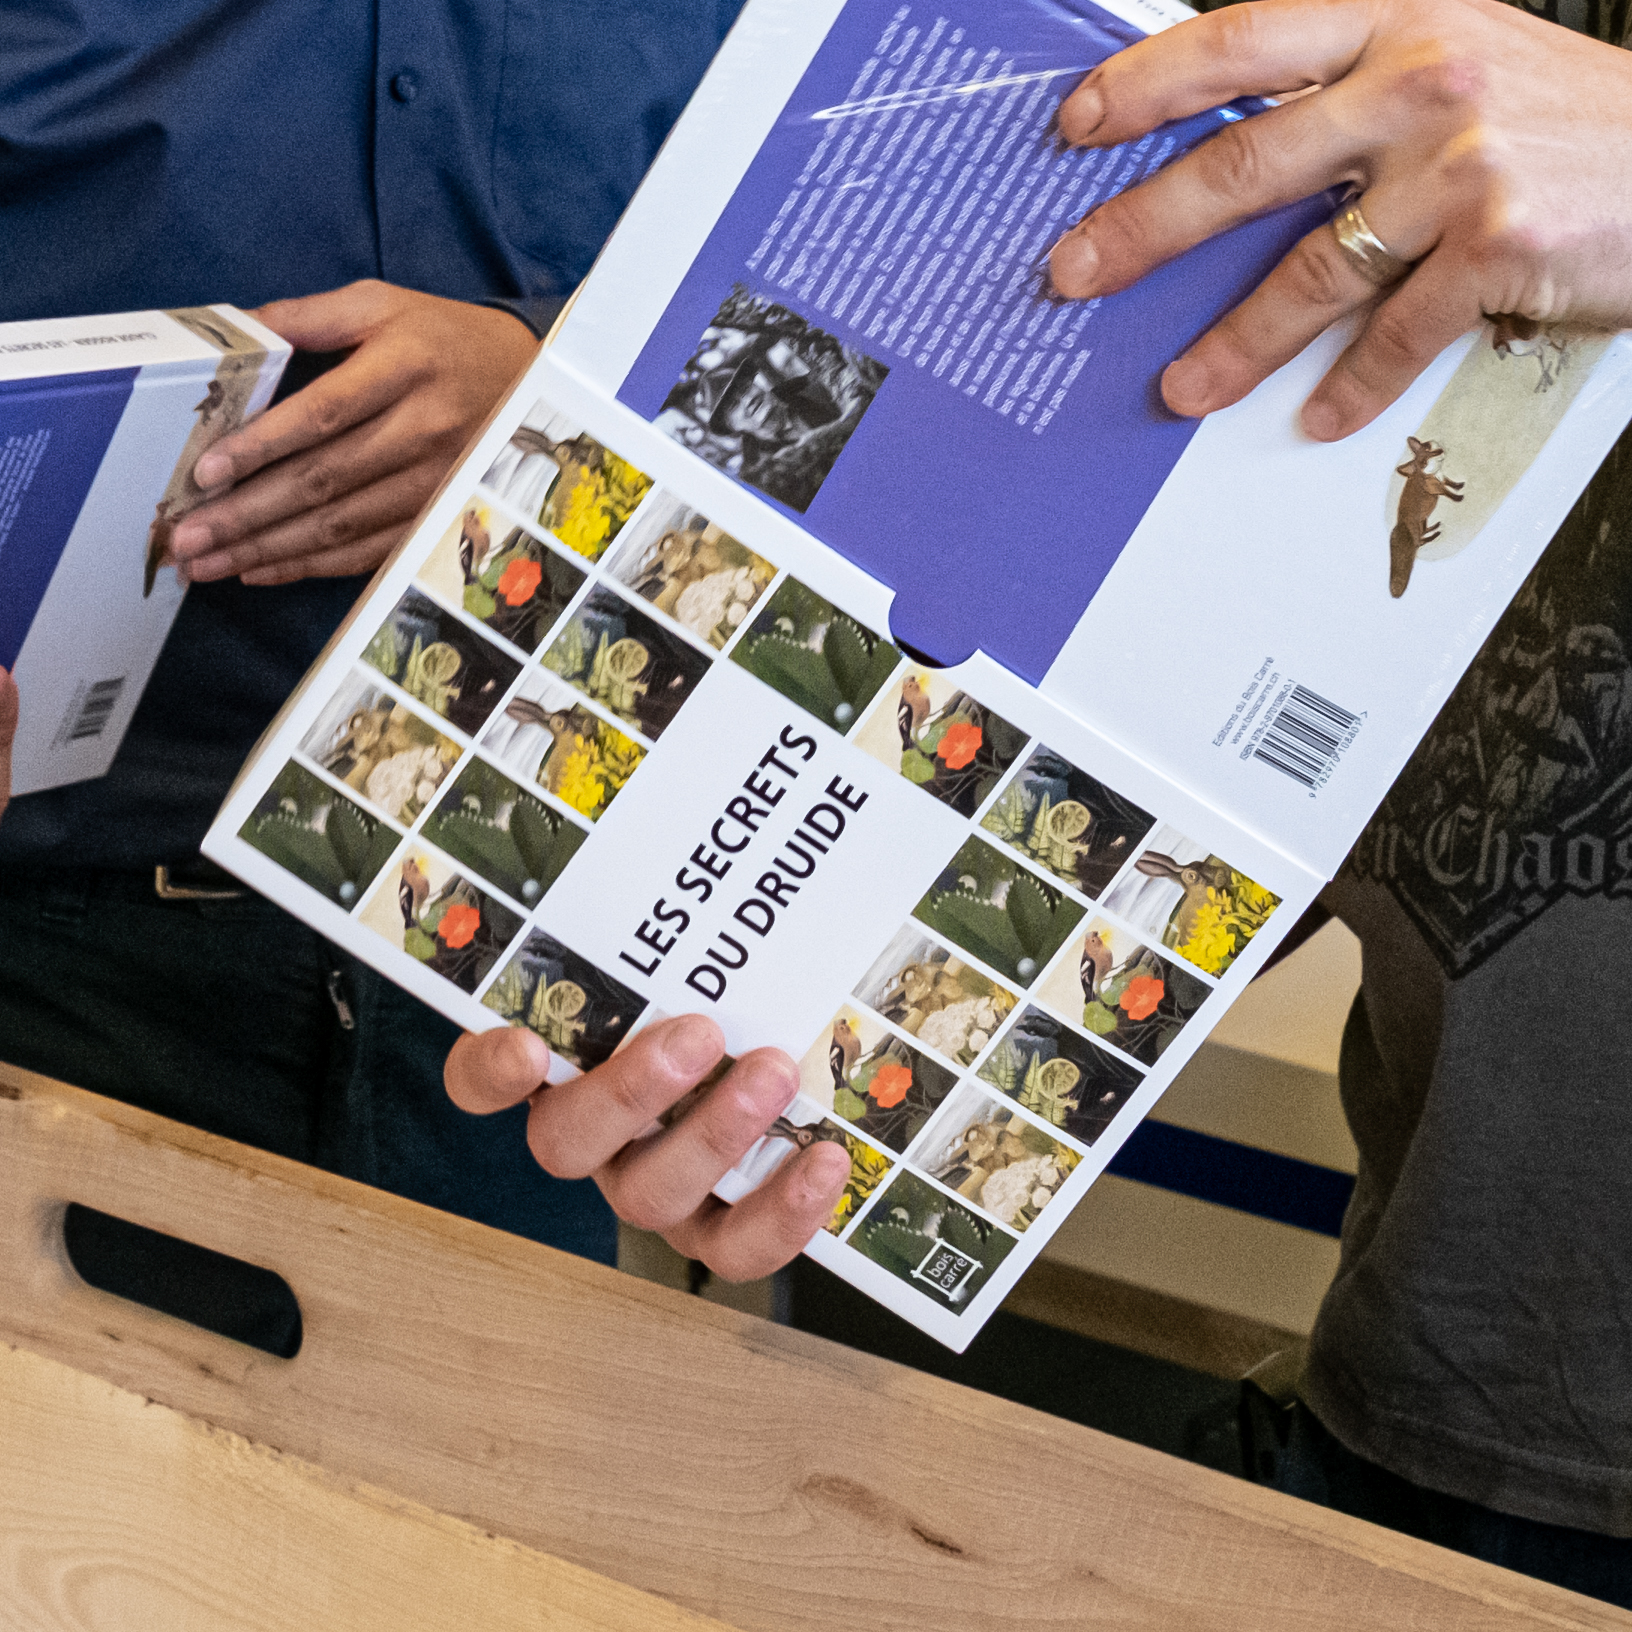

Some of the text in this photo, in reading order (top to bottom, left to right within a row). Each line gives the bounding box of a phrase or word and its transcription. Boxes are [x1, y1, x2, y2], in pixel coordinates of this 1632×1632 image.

[619, 724, 816, 976] LES SECRETS
[684, 775, 868, 1001] DU DRUIDE
[925, 1250, 953, 1278] bois
[938, 1256, 968, 1289] carré
